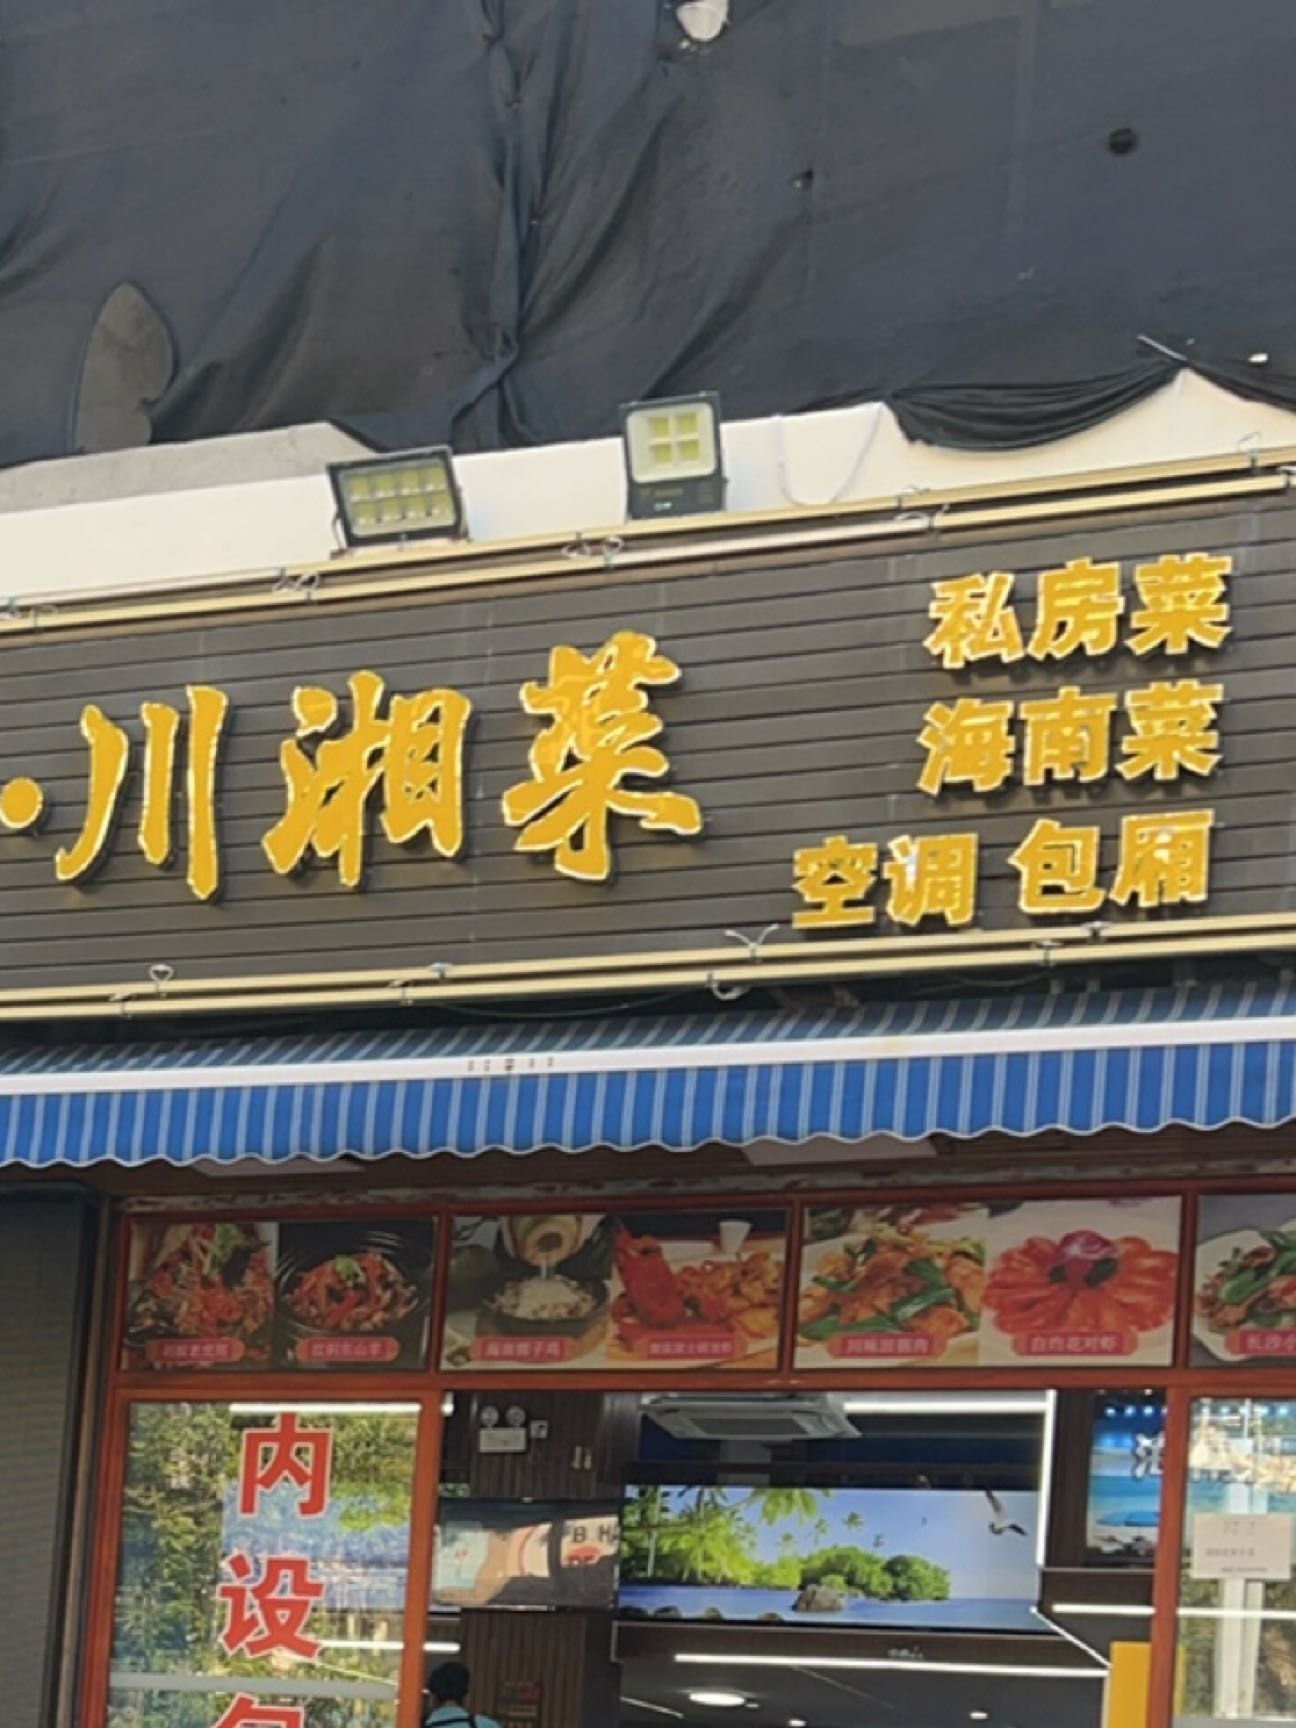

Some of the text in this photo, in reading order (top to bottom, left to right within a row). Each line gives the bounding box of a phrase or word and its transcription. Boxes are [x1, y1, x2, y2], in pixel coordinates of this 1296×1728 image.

[923, 553, 1234, 669] 私房菜
[916, 679, 1224, 797] 海南菜
[791, 808, 1215, 929] 空调 包厢
